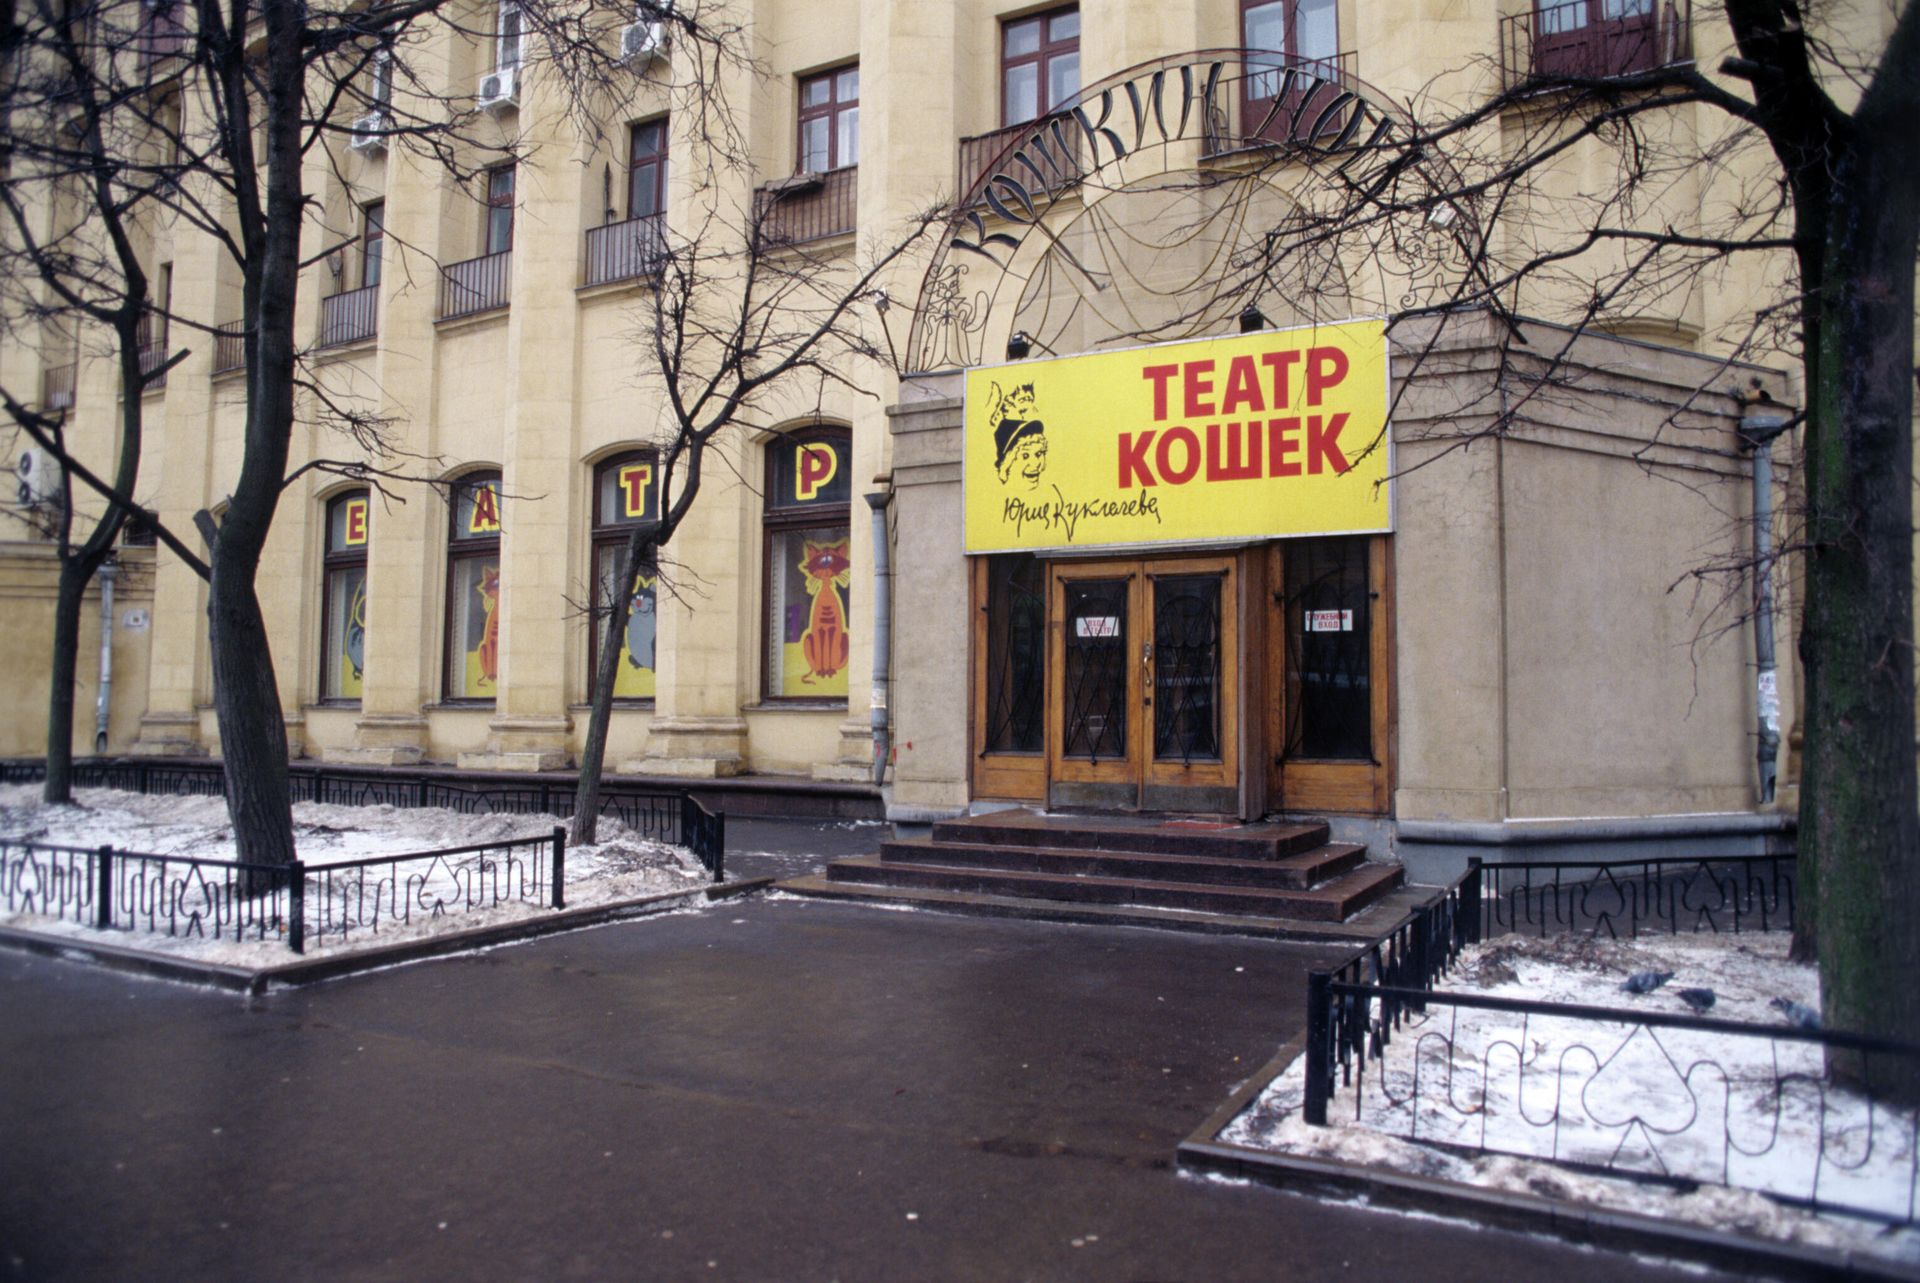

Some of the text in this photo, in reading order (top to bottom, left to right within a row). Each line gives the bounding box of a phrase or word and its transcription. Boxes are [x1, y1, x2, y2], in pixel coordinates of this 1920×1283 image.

[950, 61, 1223, 273] КОШКИН
[1142, 346, 1349, 422] ТЕАТР
[620, 464, 651, 517] Т
[796, 442, 838, 500] Р
[1118, 412, 1352, 489] КОШЕК
